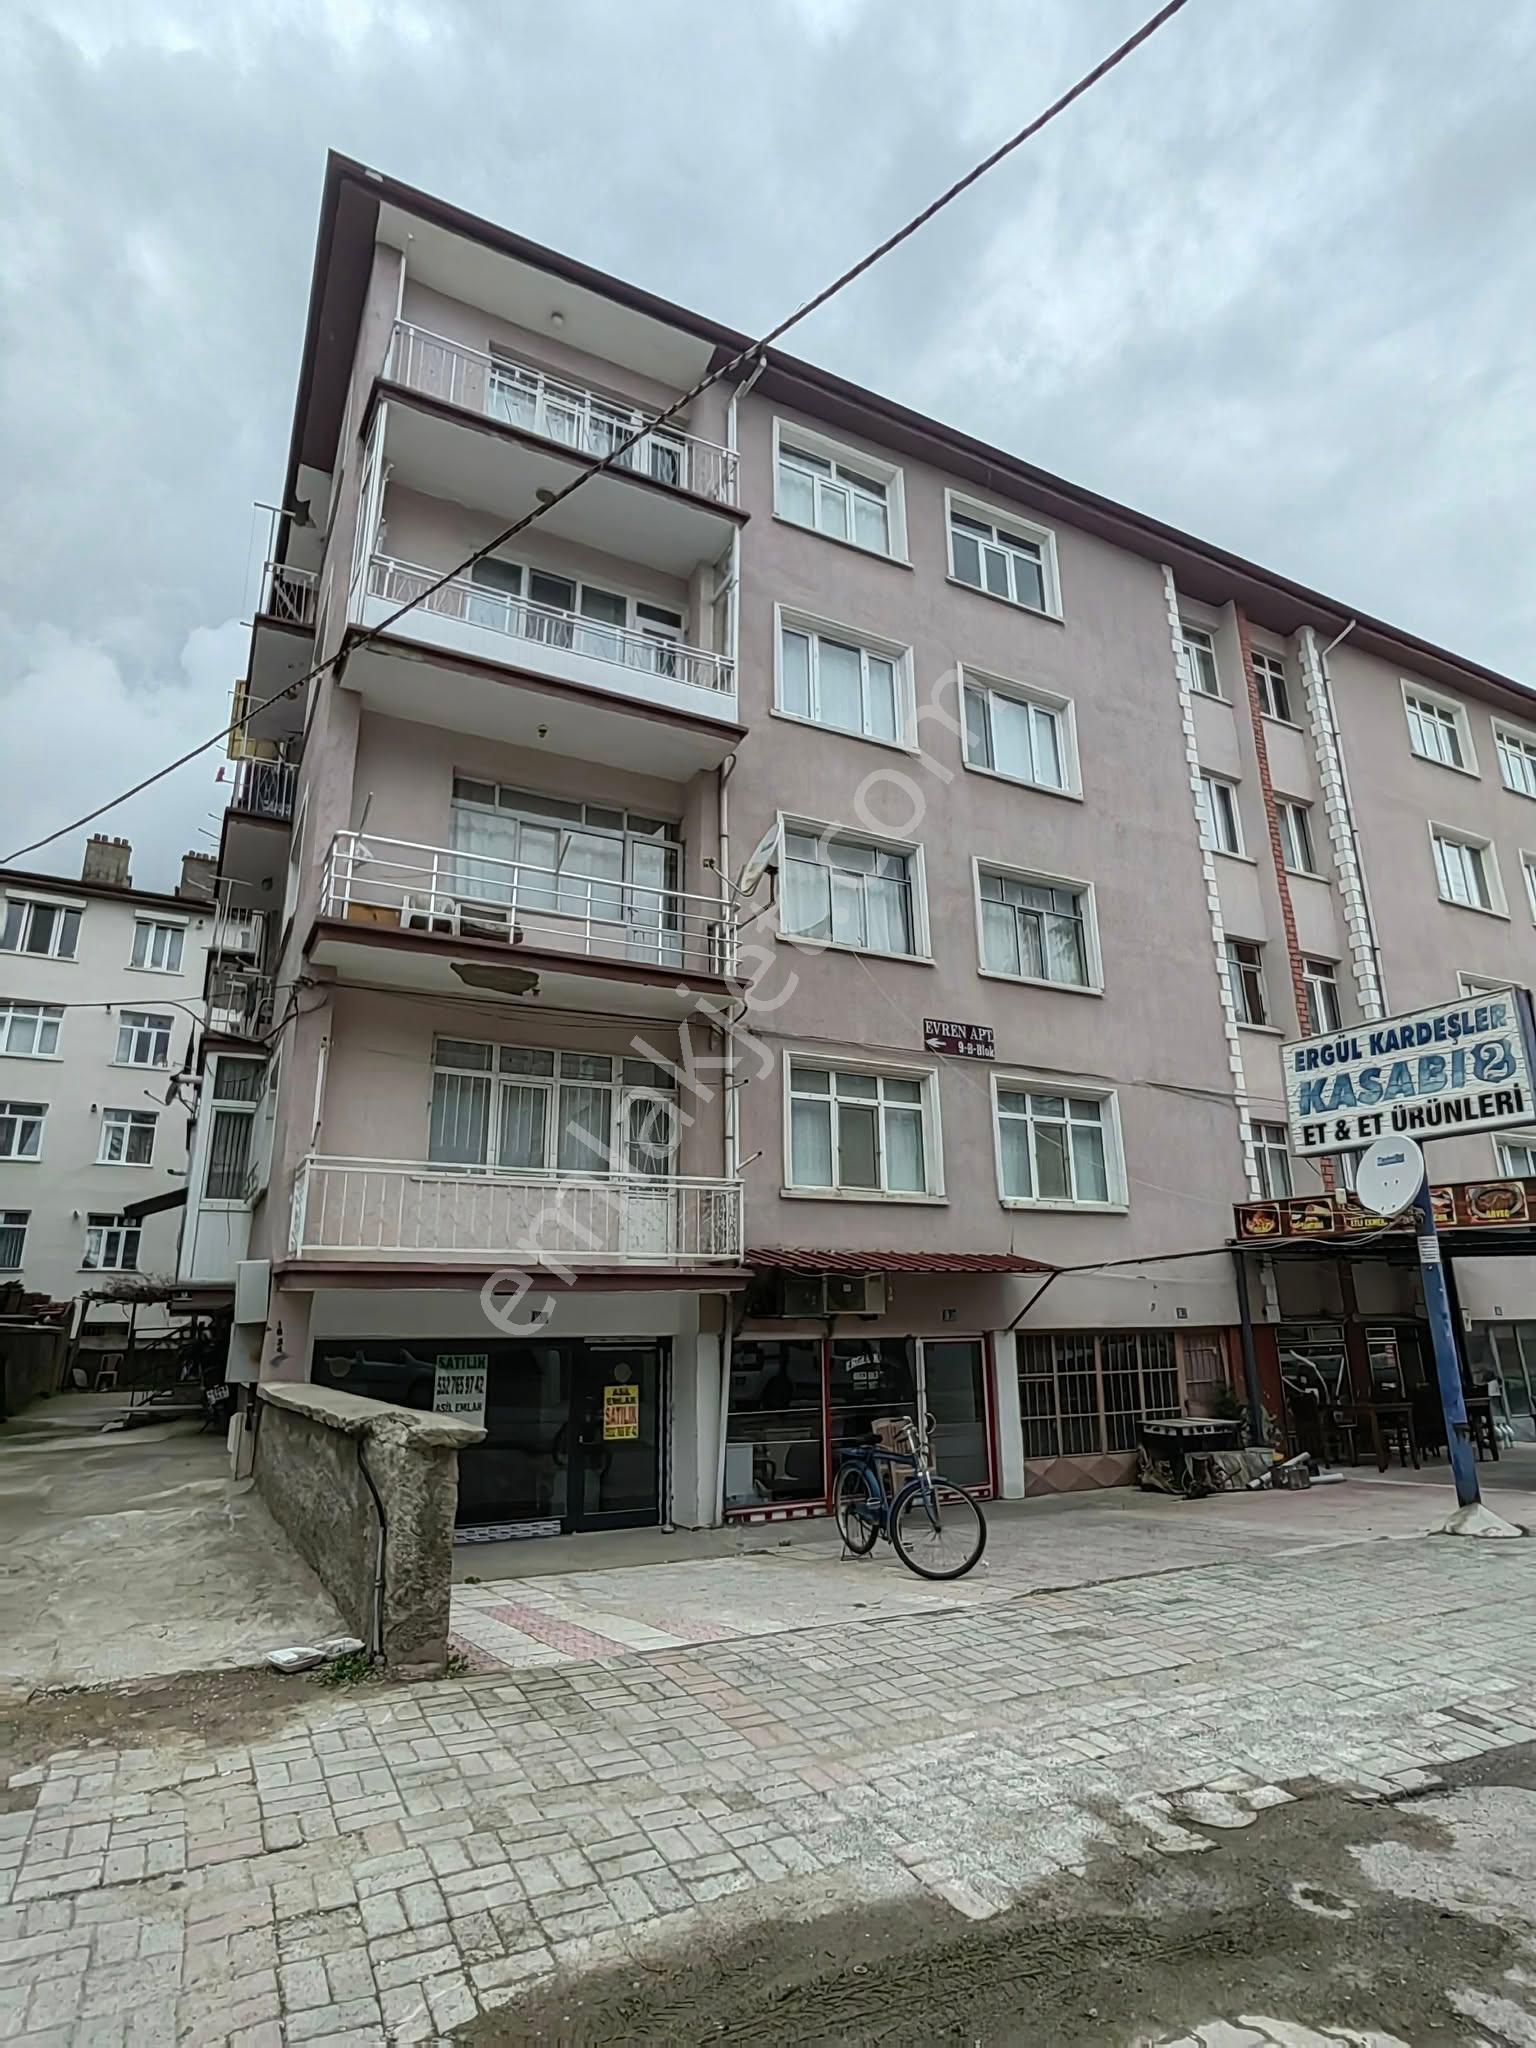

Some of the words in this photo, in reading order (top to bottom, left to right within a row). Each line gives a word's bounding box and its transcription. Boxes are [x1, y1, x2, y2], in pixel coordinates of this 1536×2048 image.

[925, 1020, 966, 1038] EVREN
[1294, 1036, 1362, 1072] ERGÜL
[1370, 1003, 1507, 1056] KARDEŞLER
[1299, 1047, 1465, 1116] KASABI
[1480, 1043, 1508, 1081] 2
[1303, 1122, 1327, 1146] ET
[1335, 1119, 1351, 1141] &
[1358, 1114, 1383, 1137] ET
[1391, 1083, 1525, 1132] ÜRÜNLERİ
[438, 1355, 486, 1370] SATILIK
[455, 1401, 482, 1413] EMLAK
